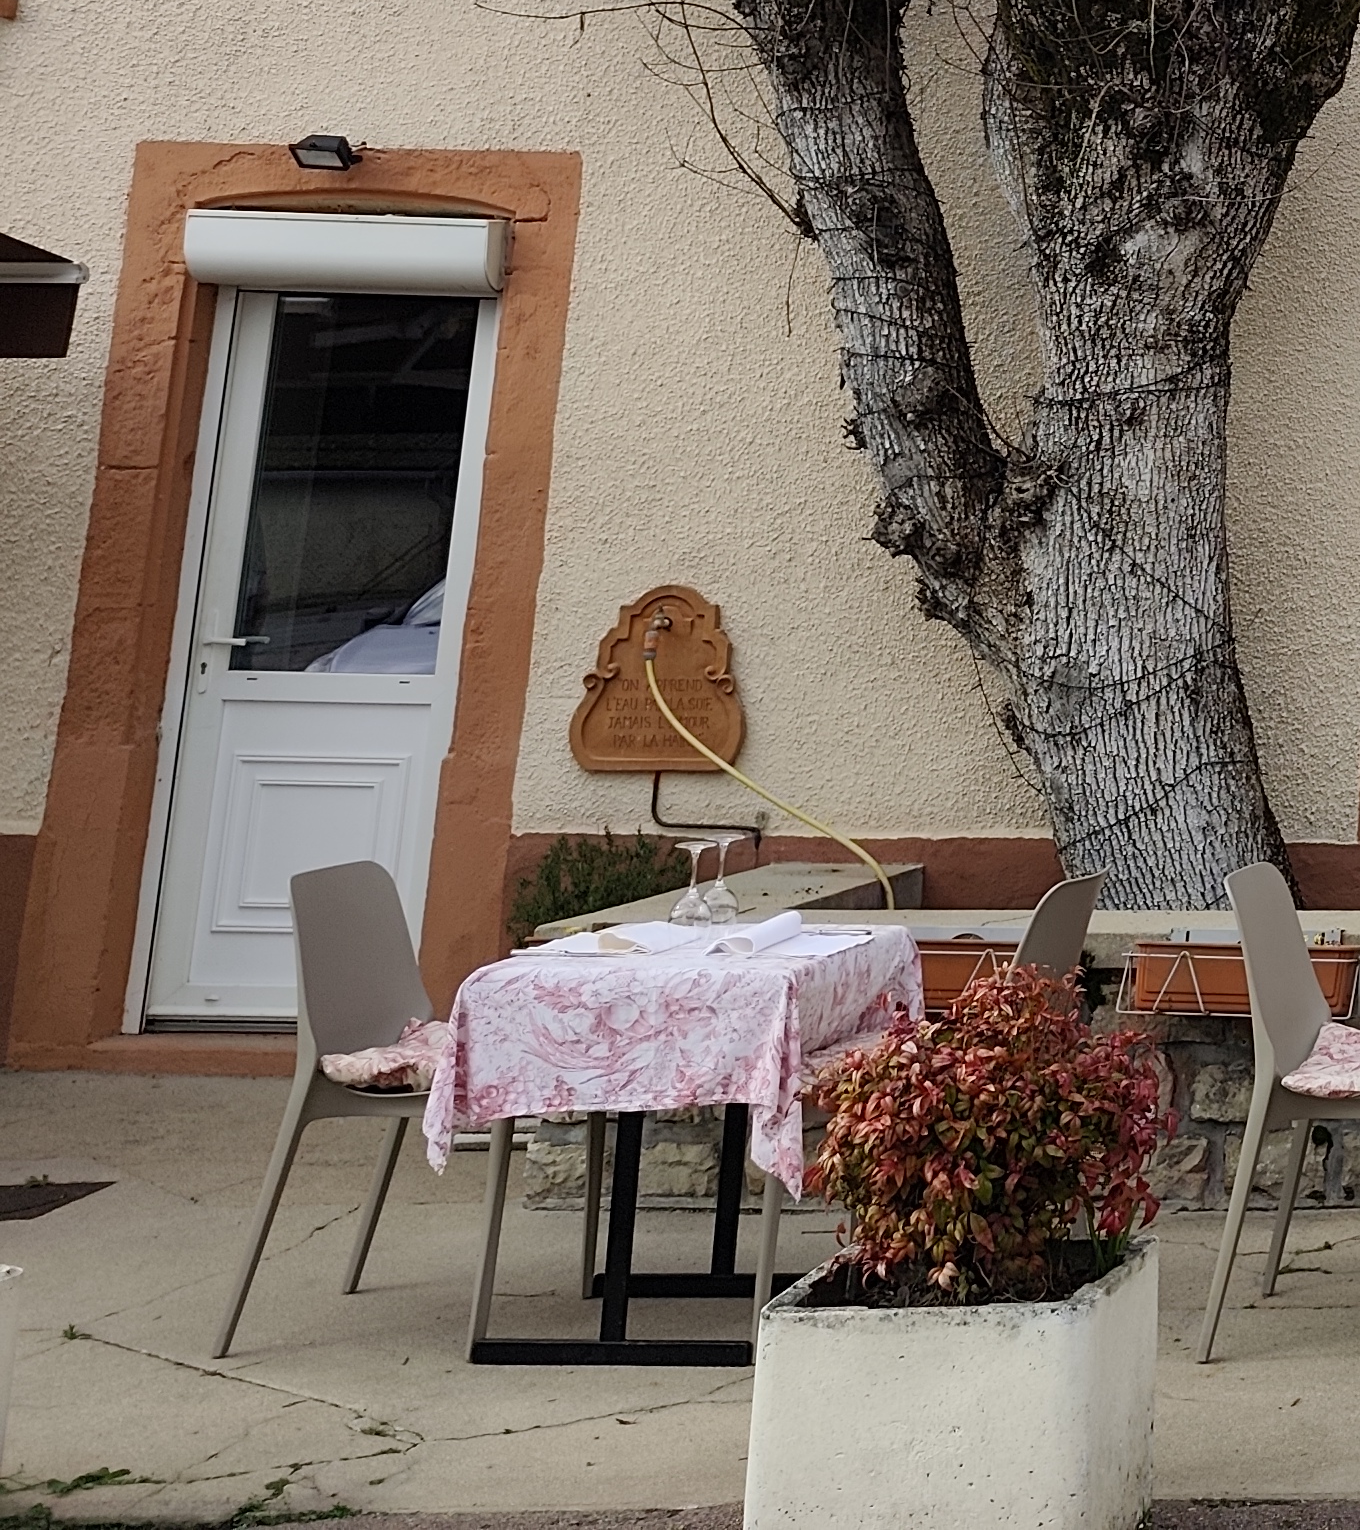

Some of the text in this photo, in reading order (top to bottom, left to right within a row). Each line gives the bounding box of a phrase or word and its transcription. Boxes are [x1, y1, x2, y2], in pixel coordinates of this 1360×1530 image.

[608, 716, 651, 729] JAMAIS
[613, 734, 636, 748] PAR
[643, 734, 659, 748] LA
